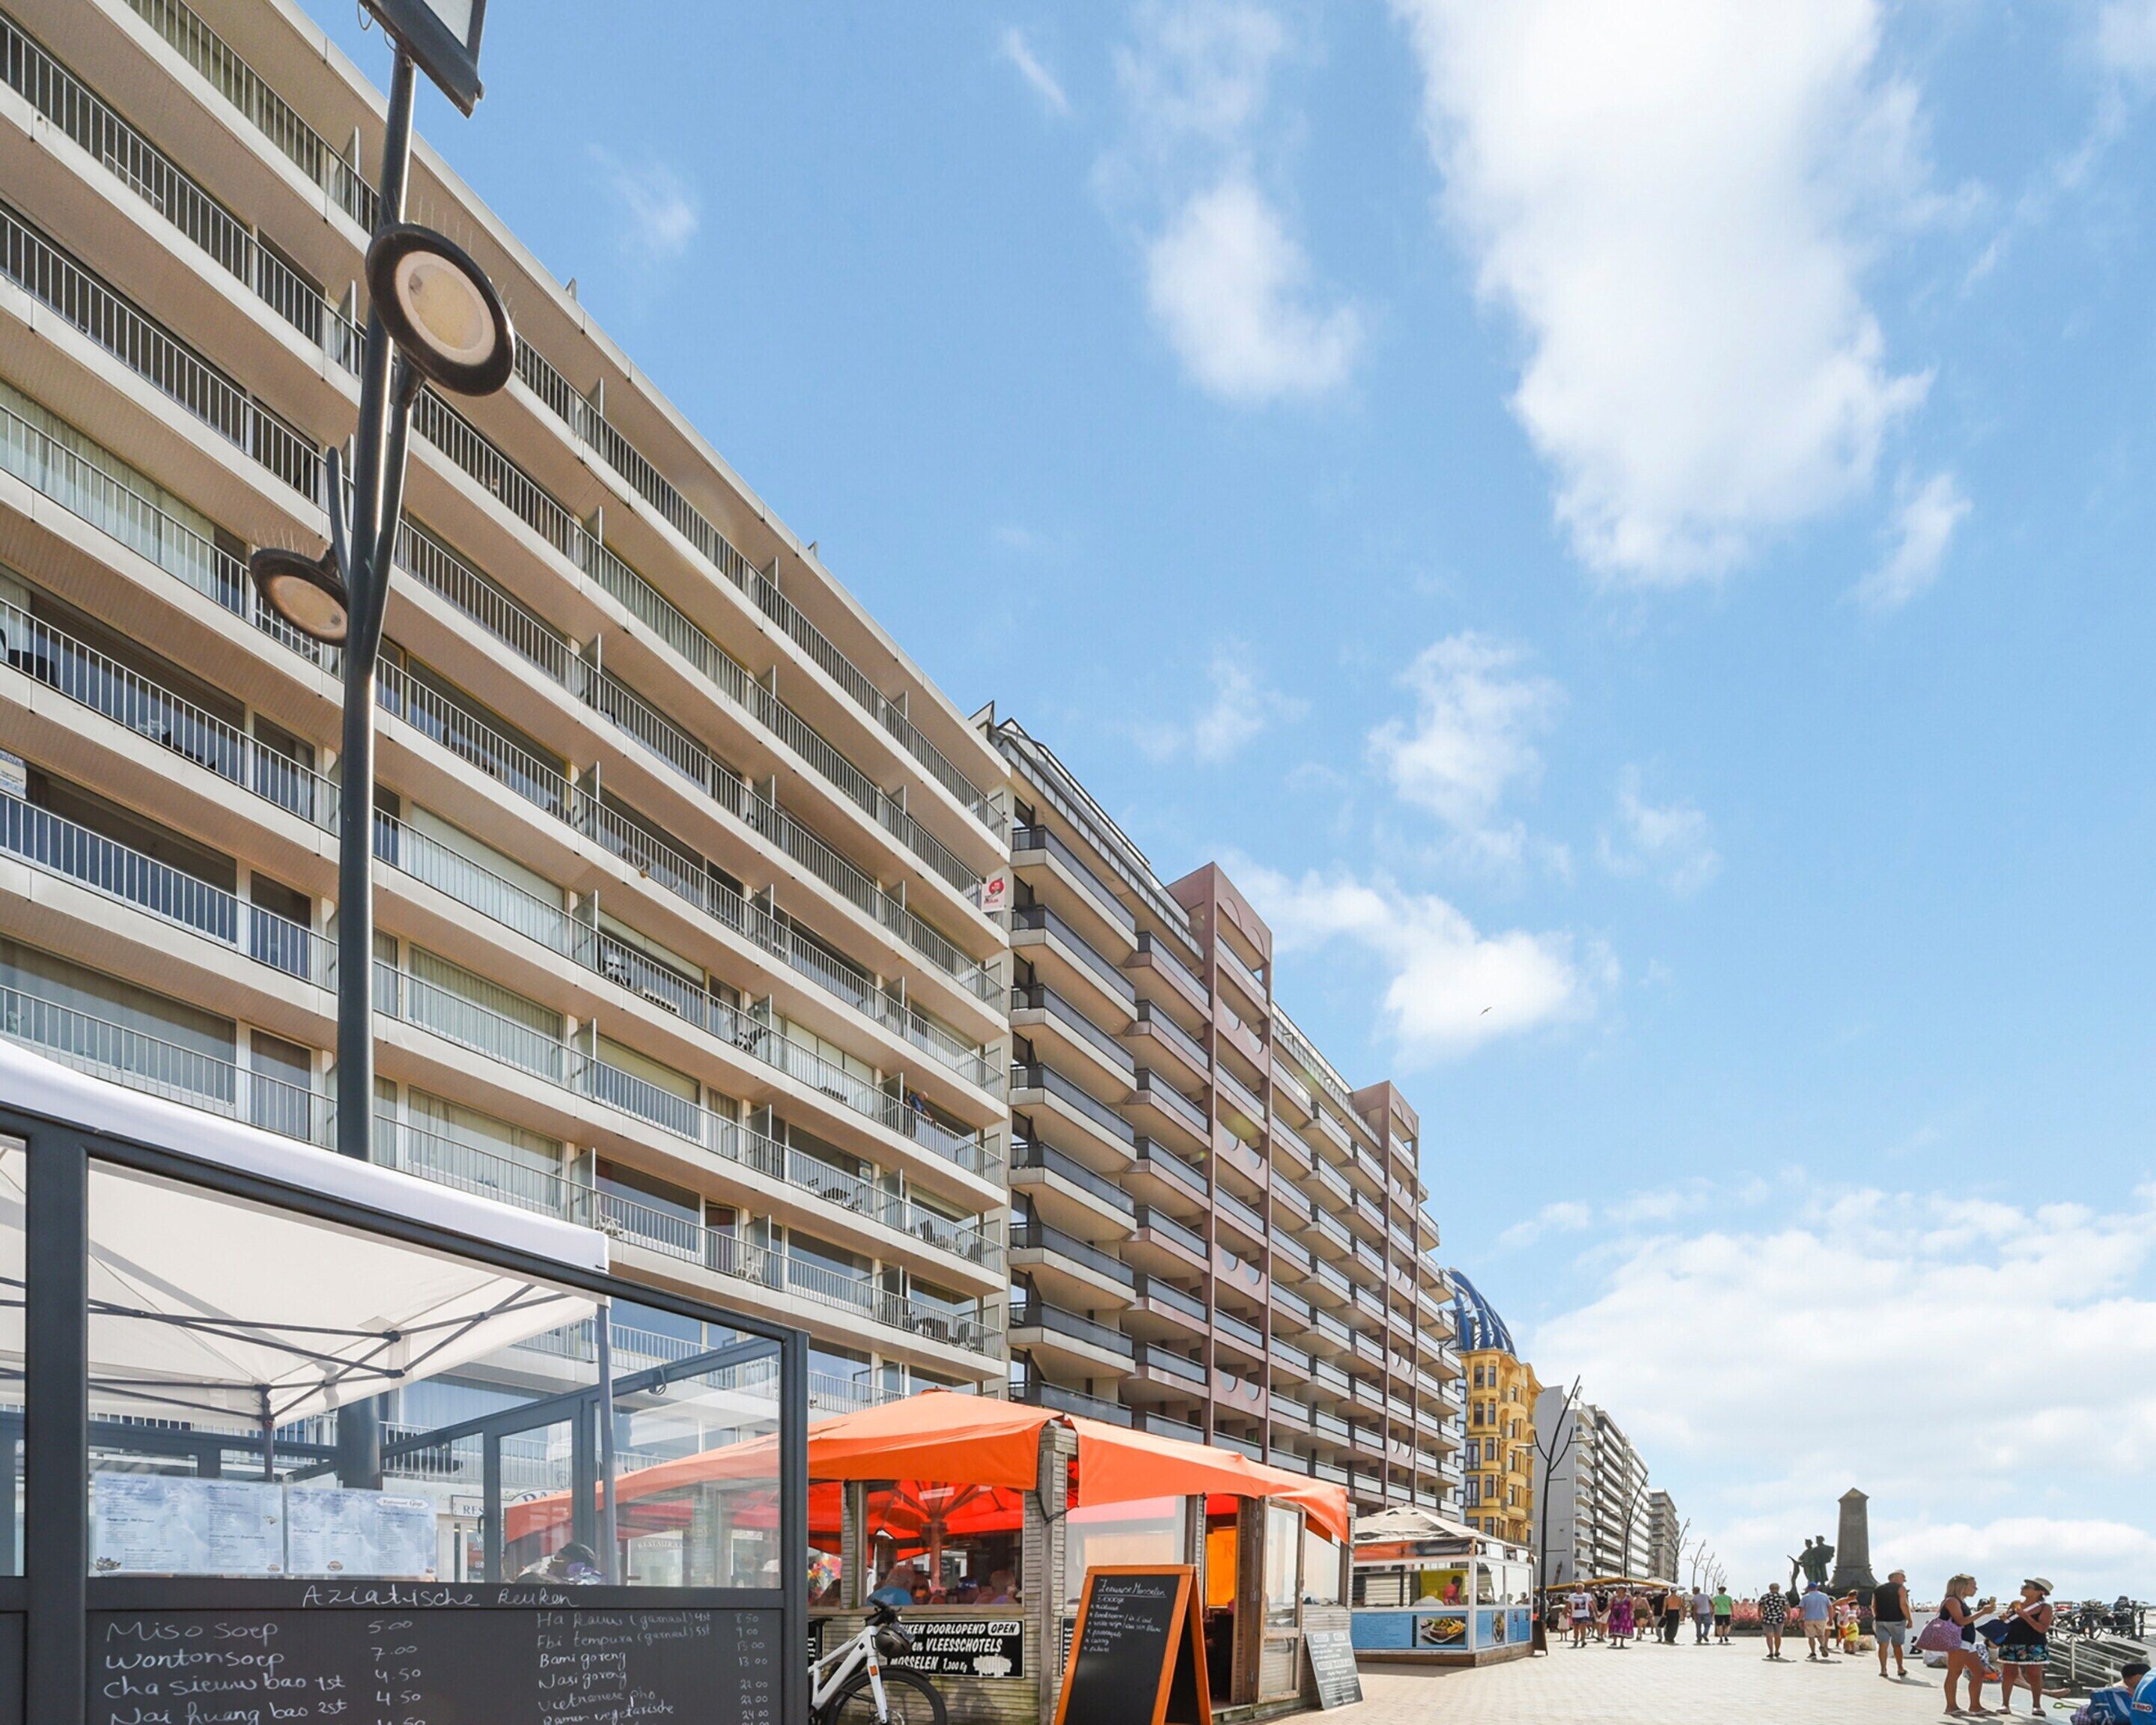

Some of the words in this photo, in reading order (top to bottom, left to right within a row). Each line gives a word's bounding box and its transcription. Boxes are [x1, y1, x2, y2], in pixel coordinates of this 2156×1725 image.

[107, 1622, 203, 1642] Miso
[926, 1622, 986, 1635] DOORLOPEND
[990, 1623, 1017, 1634] OPEN
[574, 1631, 633, 1651] tempura
[912, 1640, 924, 1652] en
[925, 1637, 1003, 1653] VLEESSCHOTELS
[540, 1652, 576, 1668] Bami
[580, 1651, 627, 1671] goreng
[262, 1673, 306, 1690] bao
[375, 1668, 421, 1683] 4.50
[582, 1670, 627, 1690] goreng
[269, 1701, 308, 1719] bao
[317, 1698, 347, 1715] 2st
